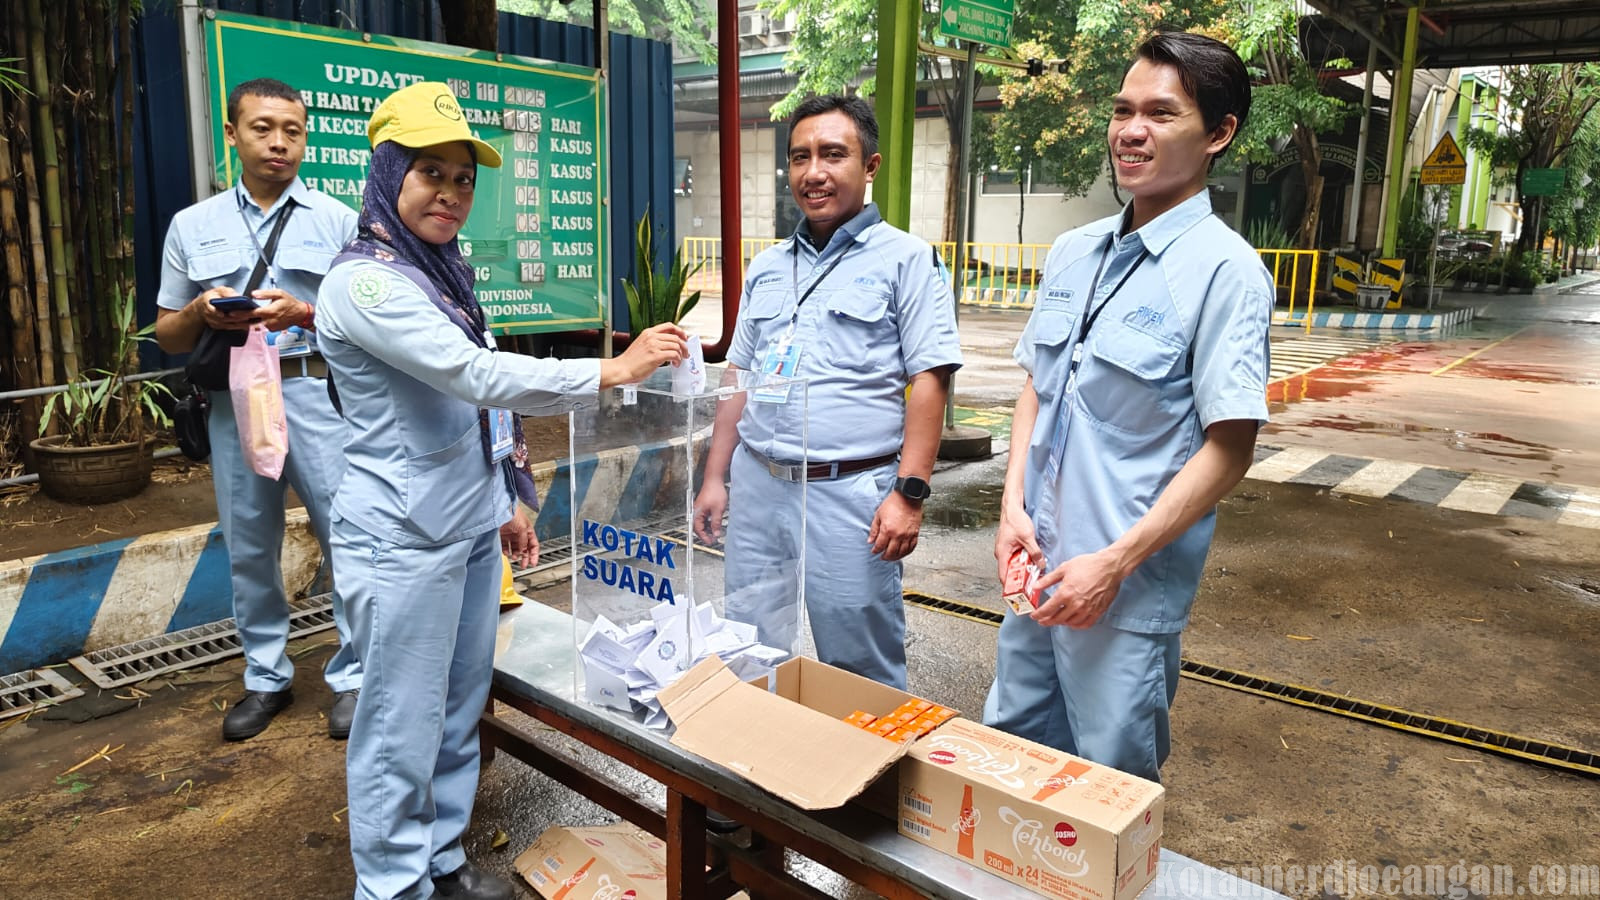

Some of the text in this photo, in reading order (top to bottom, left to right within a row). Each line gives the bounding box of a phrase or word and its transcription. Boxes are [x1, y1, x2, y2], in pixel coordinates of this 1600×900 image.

[317, 92, 359, 112] HARI
[362, 97, 384, 112] TA
[449, 79, 470, 98] 18
[478, 83, 497, 101] 11
[505, 86, 545, 107] 2025
[462, 108, 501, 126] ERJA
[551, 118, 581, 135] HARI
[320, 147, 368, 166] FIRST
[550, 138, 592, 155] KASUS
[515, 159, 592, 180] 05 KASUS
[516, 186, 592, 206] 04 KASUS
[517, 213, 593, 232] 03 KASUS
[518, 240, 593, 259] 02 KASUS
[521, 262, 592, 282] 14 HARI
[479, 289, 533, 302] DIVISION
[482, 303, 552, 317] NDONESIA
[583, 519, 677, 569] KOTAK
[583, 555, 676, 606] SUARA
[998, 806, 1090, 878] Tehbotol
[988, 856, 1003, 869] 200
[1026, 865, 1038, 880] 24
